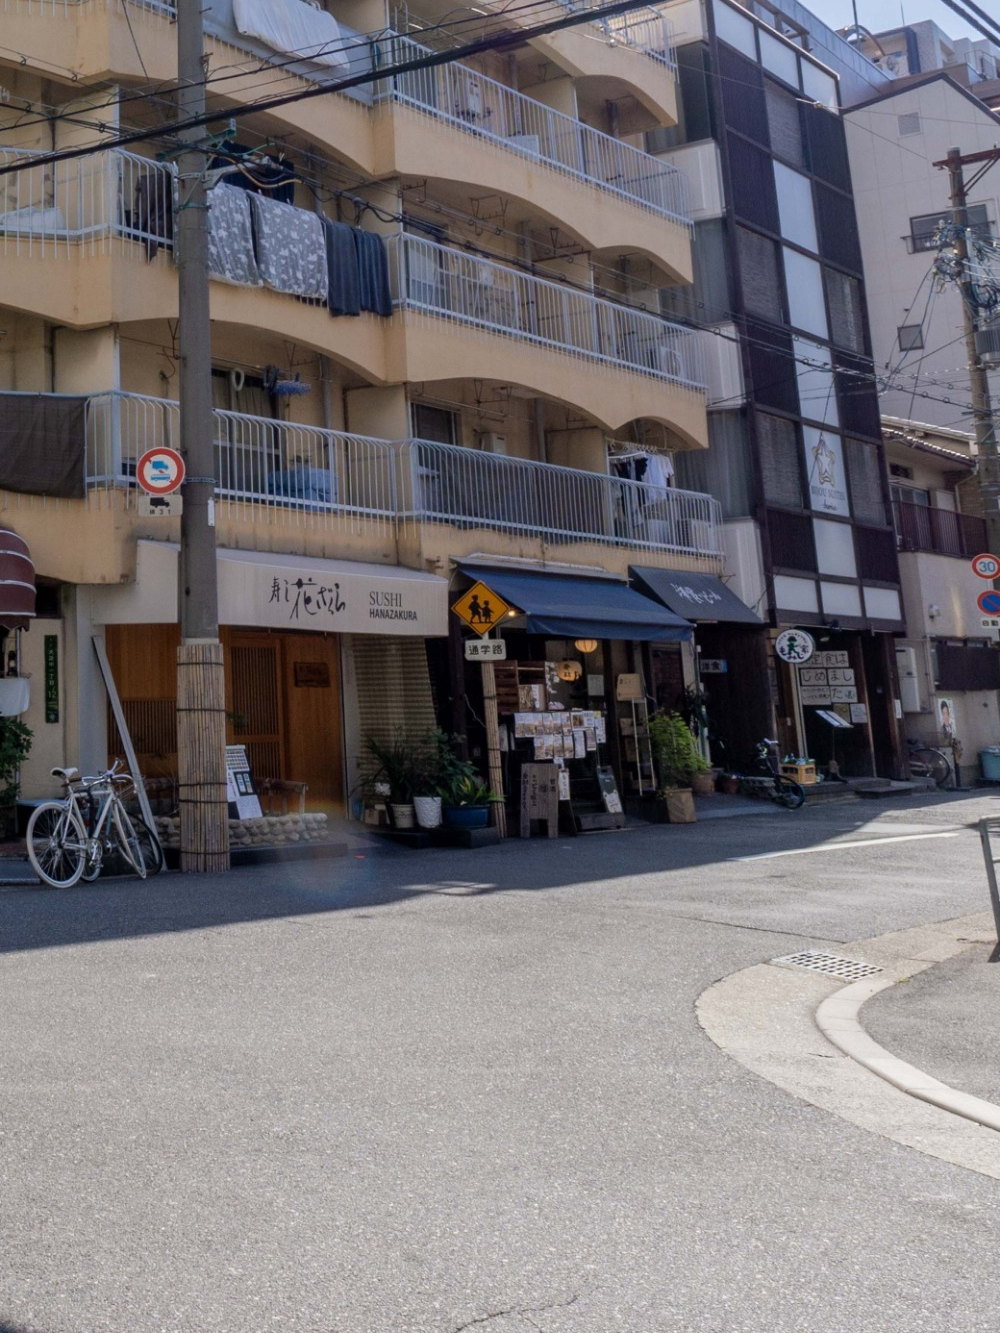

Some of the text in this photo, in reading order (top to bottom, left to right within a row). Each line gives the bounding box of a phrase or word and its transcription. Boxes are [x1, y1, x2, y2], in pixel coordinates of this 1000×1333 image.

[979, 561, 996, 573] 30
[369, 590, 403, 608] SUSHI
[369, 608, 418, 621] HANAZAKURA
[468, 644, 503, 656] 通学路
[806, 652, 847, 665] 定食は
